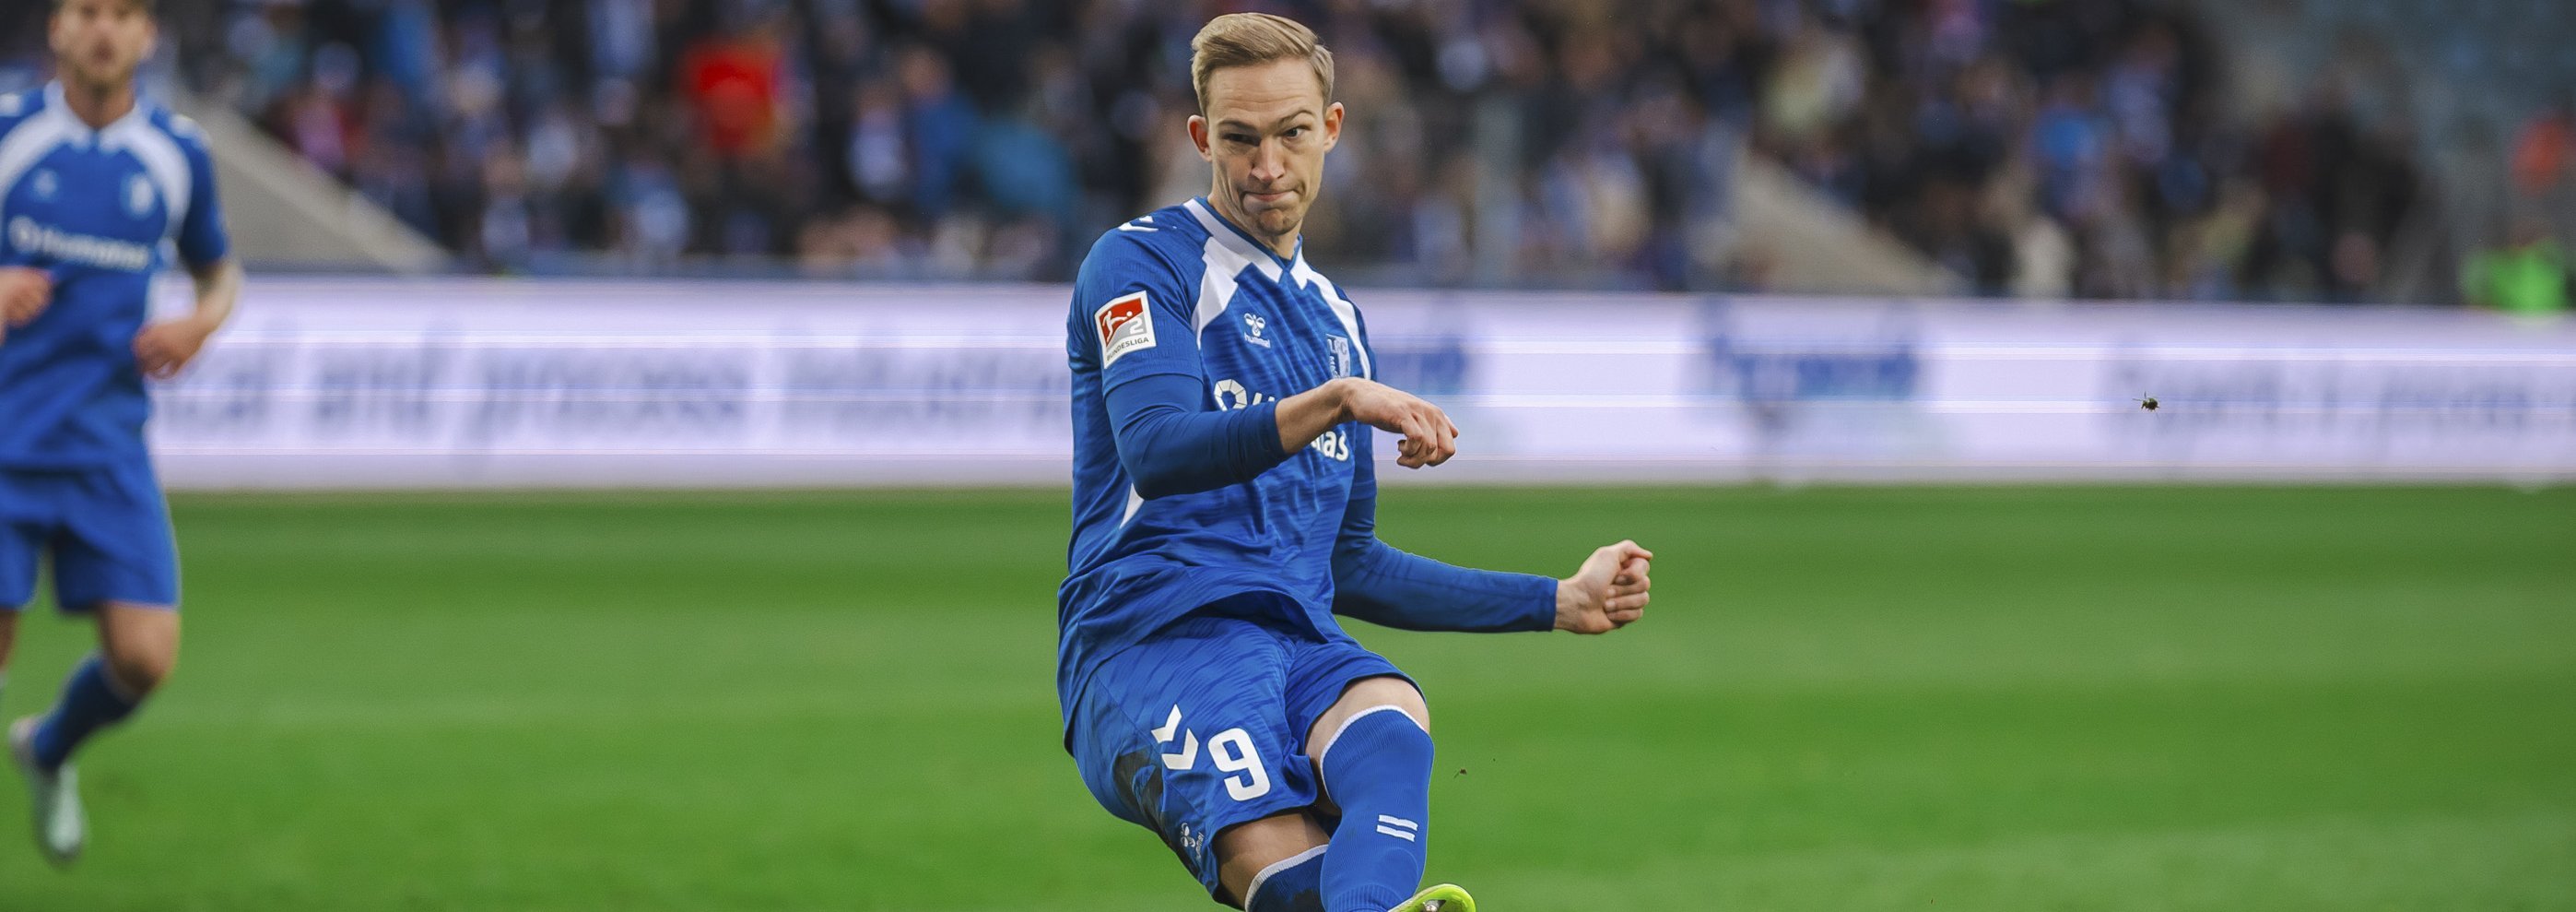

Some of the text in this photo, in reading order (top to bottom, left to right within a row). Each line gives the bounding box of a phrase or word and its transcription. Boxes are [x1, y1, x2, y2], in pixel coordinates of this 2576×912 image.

[1129, 315, 1144, 335] 2
[1106, 337, 1150, 361] BUNDESLIGA
[1207, 728, 1271, 801] 9
